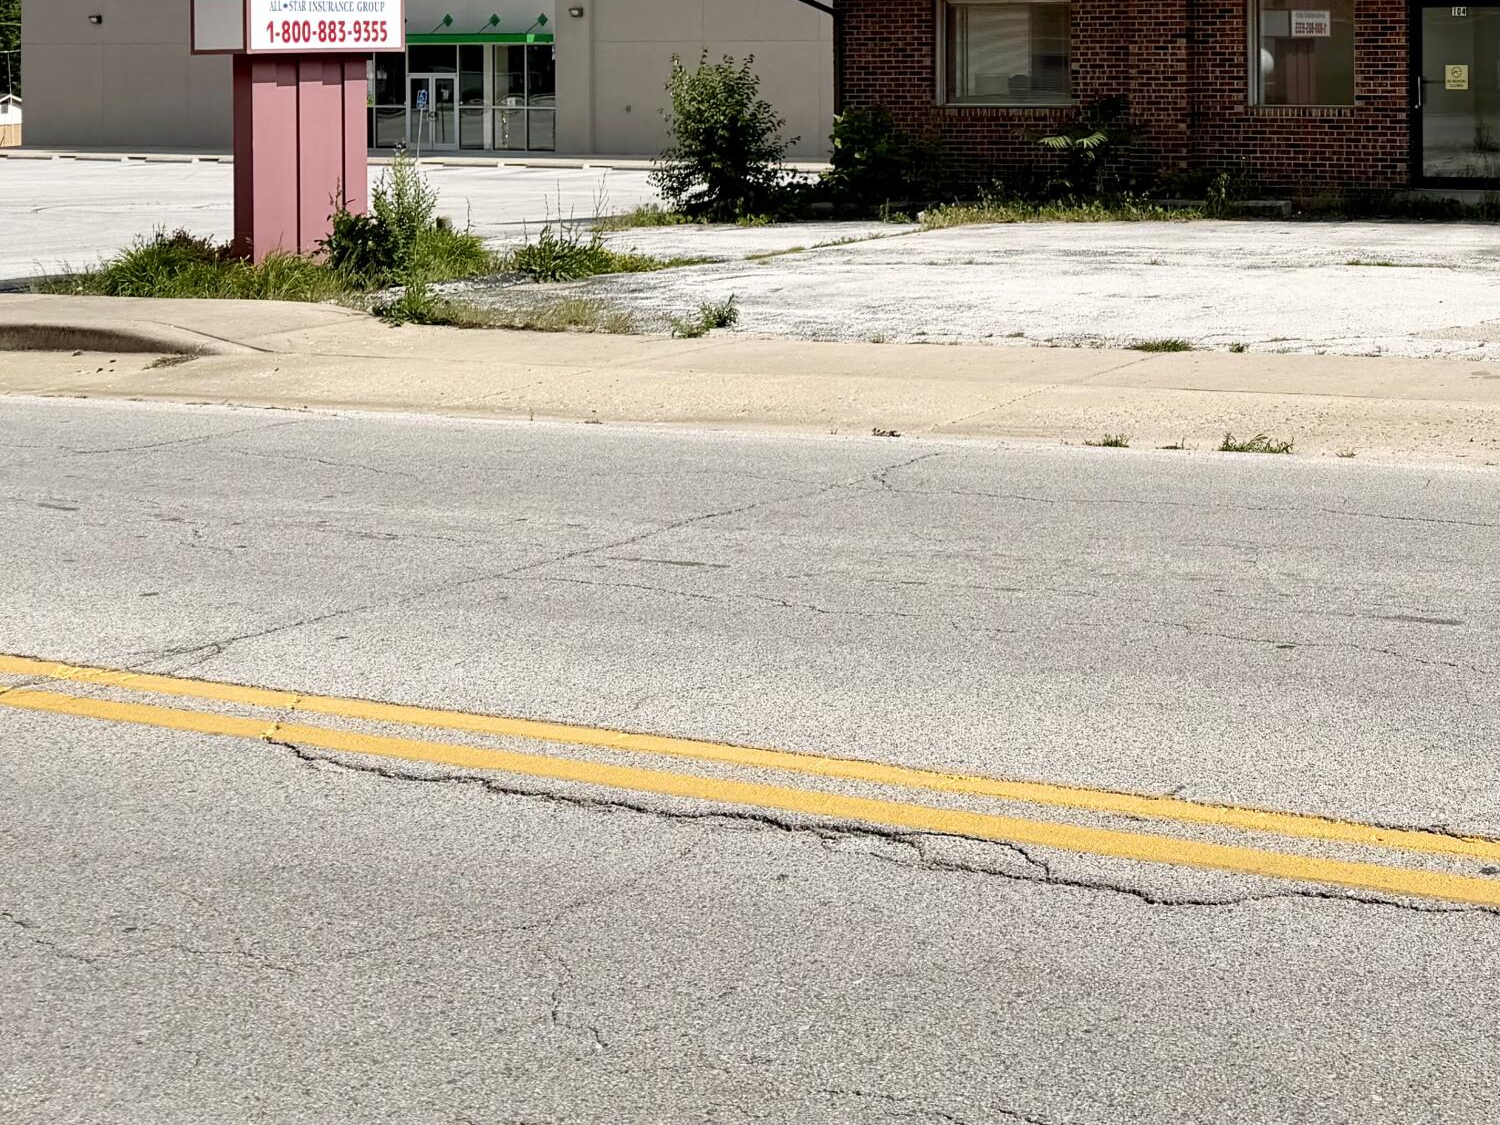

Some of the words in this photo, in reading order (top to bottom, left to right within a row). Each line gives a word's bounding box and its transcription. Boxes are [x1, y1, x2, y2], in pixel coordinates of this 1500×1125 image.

[308, 1, 354, 12] INSURANCE
[356, 1, 386, 13] GROUP
[266, 19, 388, 43] 1-800-883-9355
